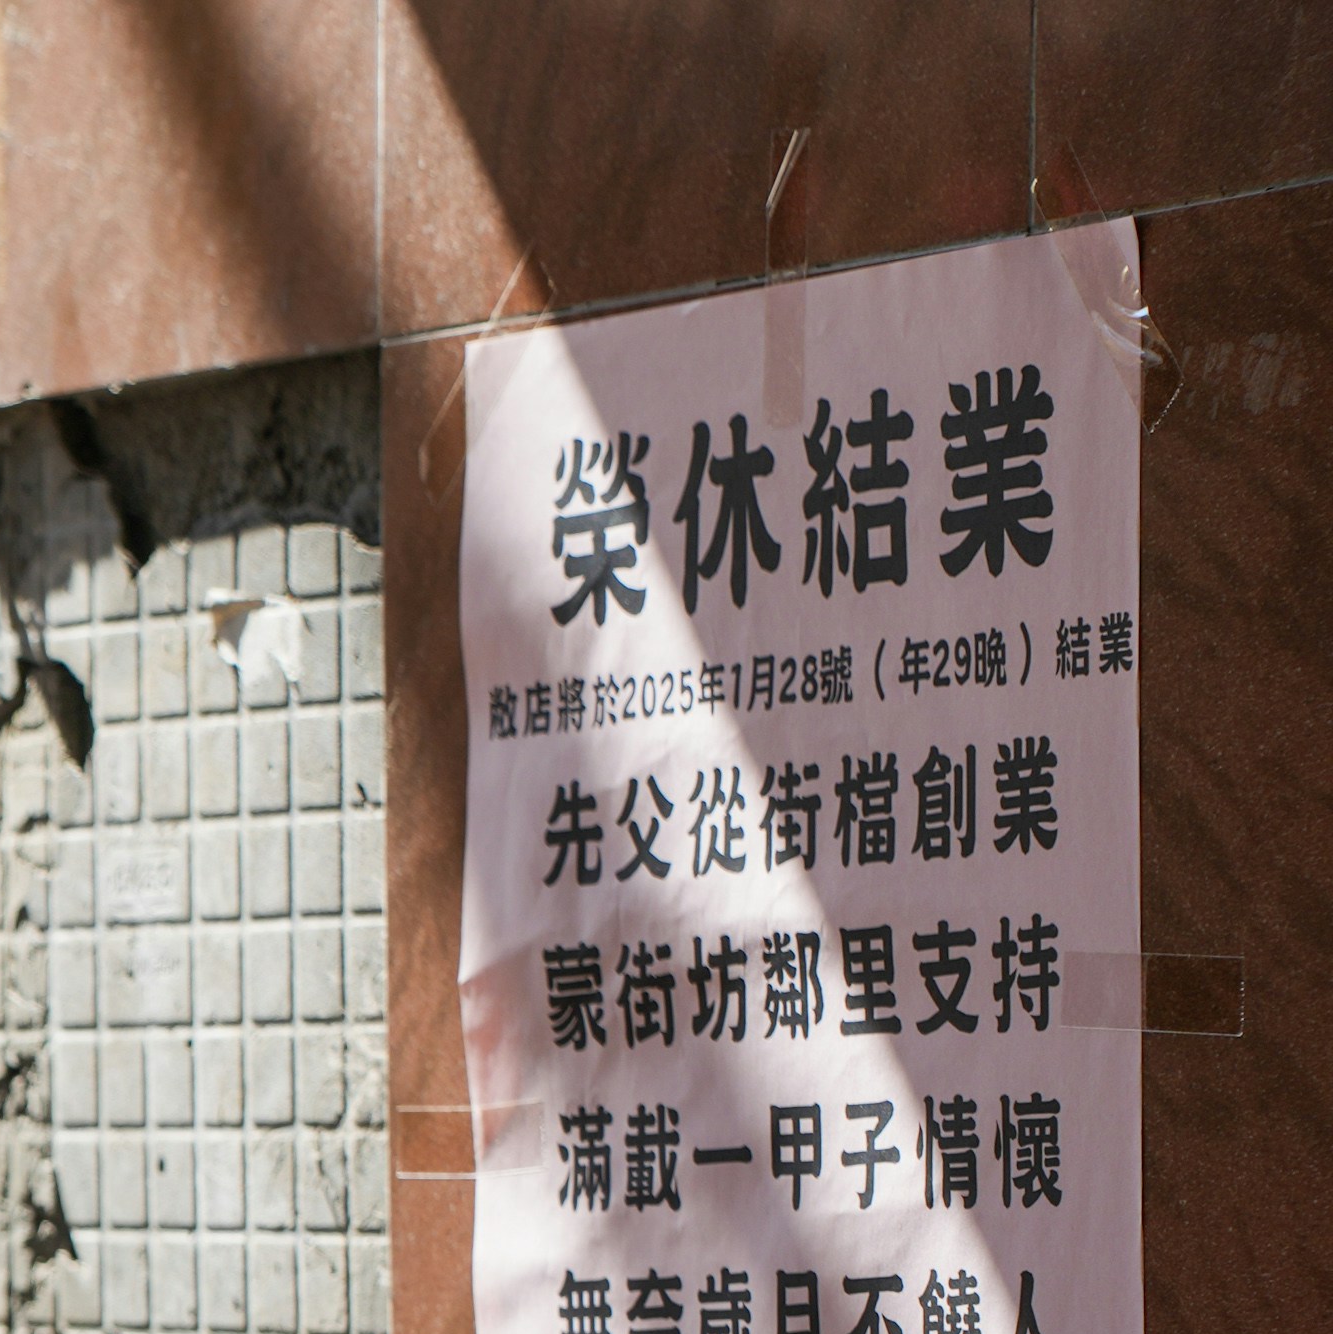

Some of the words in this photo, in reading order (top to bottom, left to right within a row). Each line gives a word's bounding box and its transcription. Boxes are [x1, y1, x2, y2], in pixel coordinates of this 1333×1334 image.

[550, 364, 1055, 629] 榮休結業
[541, 735, 1060, 887] 先父從街檔創業
[541, 912, 1061, 1052] 蒙街坊鄰里支持
[557, 1091, 1064, 1212] 滿載一甲子情懷
